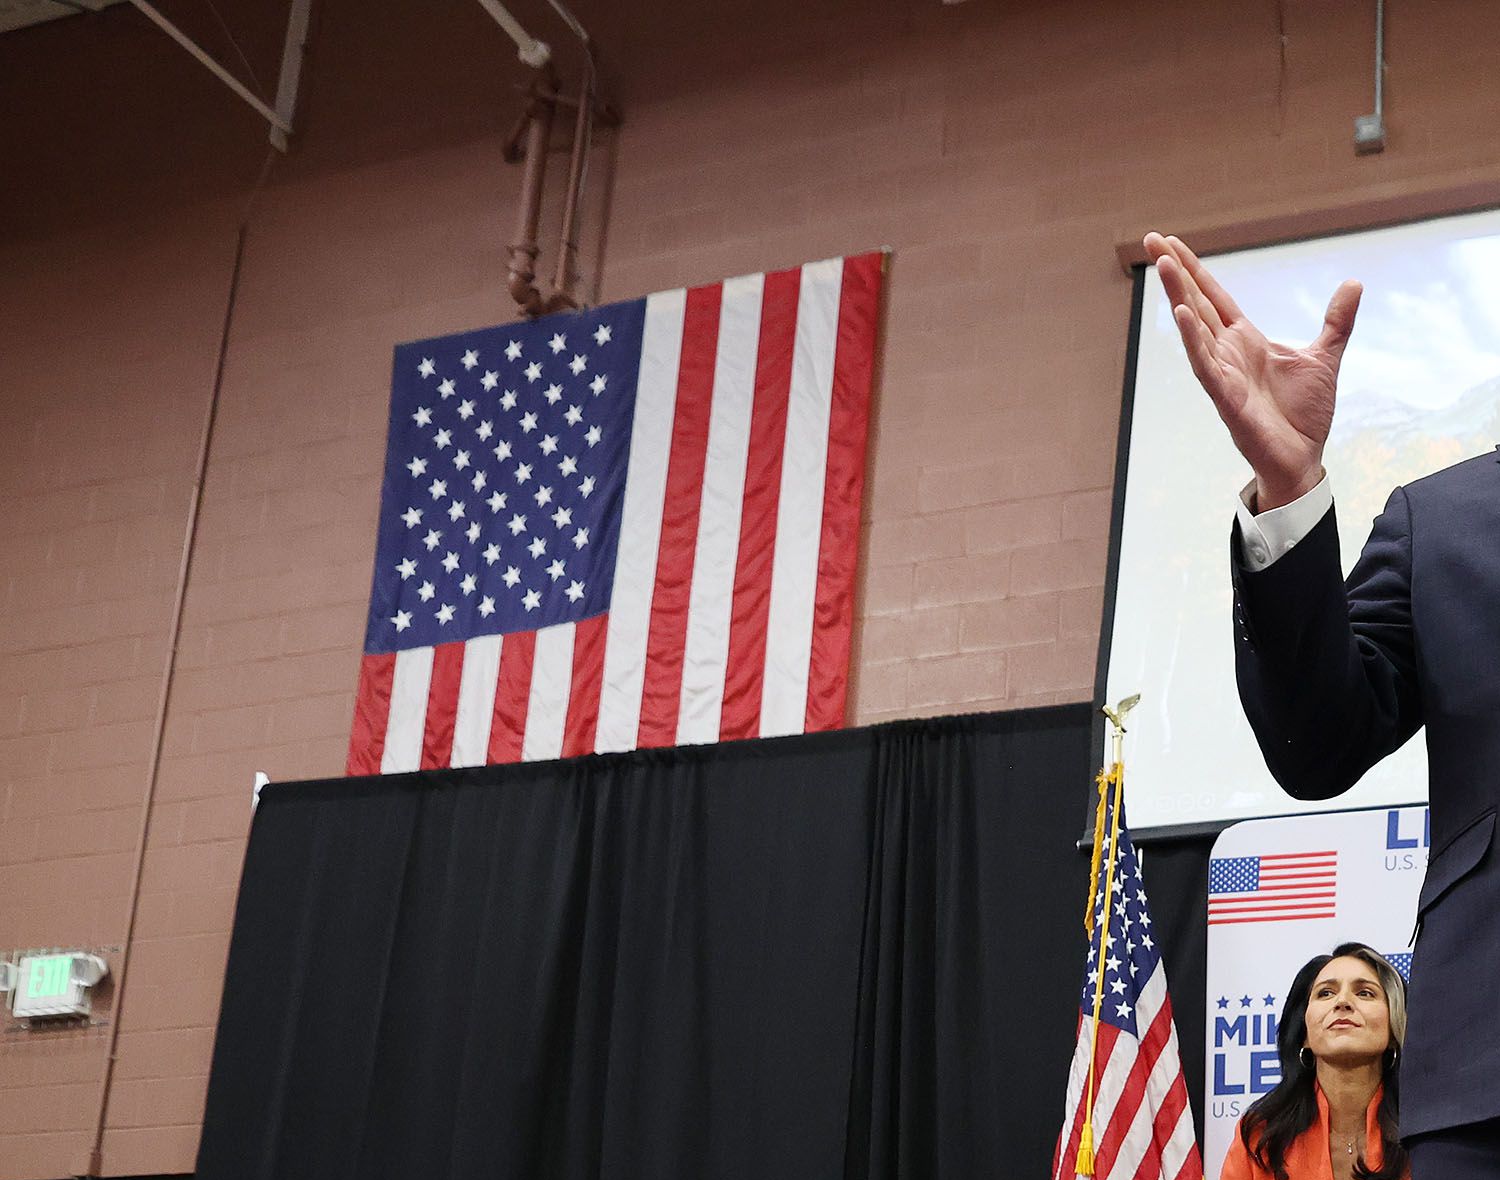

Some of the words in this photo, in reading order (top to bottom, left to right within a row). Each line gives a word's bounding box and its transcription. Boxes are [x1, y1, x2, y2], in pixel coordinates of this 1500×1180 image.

[1385, 854, 1418, 871] U.S.
[1213, 1049, 1281, 1096] LE
[1212, 1101, 1241, 1118] U.S
